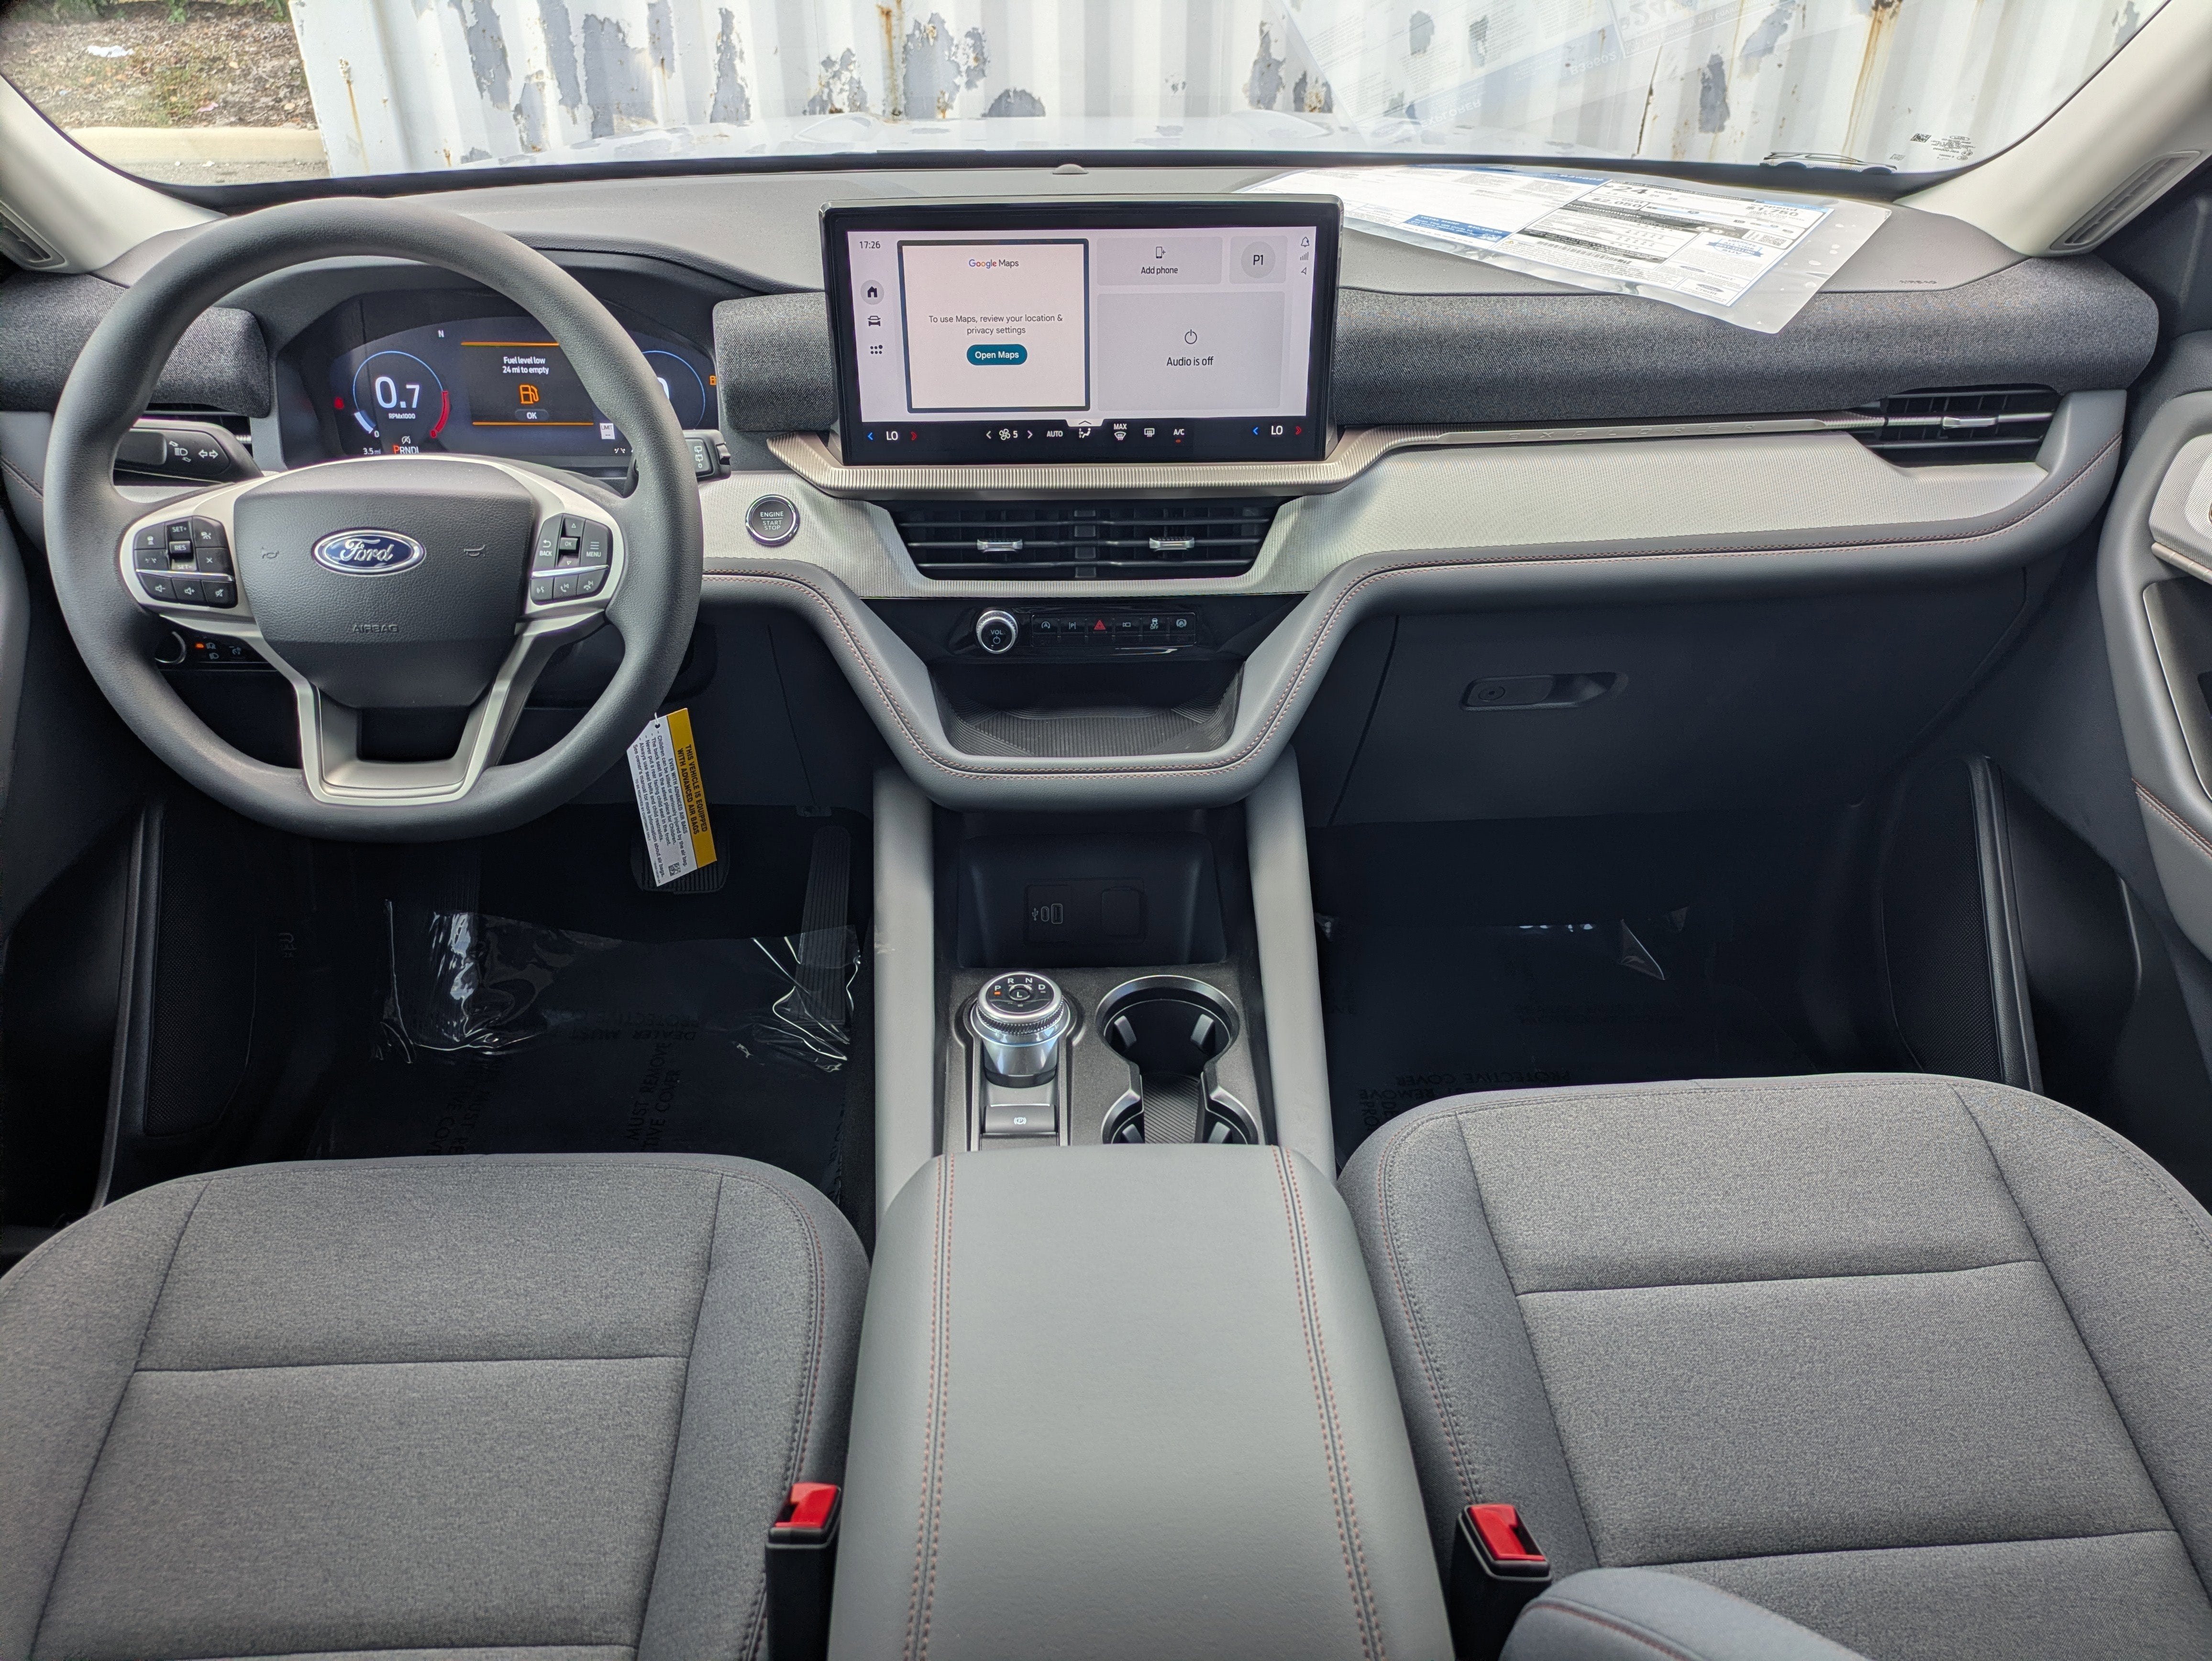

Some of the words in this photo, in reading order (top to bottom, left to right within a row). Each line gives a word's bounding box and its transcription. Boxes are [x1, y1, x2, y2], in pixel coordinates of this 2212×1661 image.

[859, 241, 881, 249] 17:26
[969, 259, 997, 269] Google
[999, 259, 1019, 268] Maps
[1252, 255, 1264, 266] P1
[1156, 266, 1178, 275] phone
[929, 315, 938, 323] To
[956, 315, 978, 324] Maps,
[980, 315, 1004, 323] review
[1006, 316, 1023, 324] your
[1025, 314, 1055, 323] location
[438, 330, 444, 338] N
[967, 327, 994, 336] privacy
[996, 326, 1026, 336] settings
[974, 351, 996, 361] Open
[998, 351, 1019, 361] Maps
[1166, 357, 1192, 366] Audio
[1193, 357, 1200, 366] is
[1201, 356, 1214, 366] off
[529, 366, 549, 375] empty
[375, 376, 420, 408] 0.7
[1013, 431, 1018, 439] 5
[1271, 426, 1283, 435] LO
[886, 432, 898, 441] LO
[340, 538, 395, 562] Ford
[352, 624, 399, 633] AIRBAG
[677, 747, 686, 767] WITH
[685, 743, 694, 761] THIS
[657, 735, 665, 757] Children
[668, 794, 677, 816] seriously
[688, 761, 699, 790] VEHICLE
[681, 766, 693, 803] ADVANCED
[638, 742, 646, 761] Always
[655, 817, 664, 842] restraints.
[694, 790, 701, 798] IS
[674, 785, 683, 811] ADVANCED
[696, 798, 708, 833] EQUIPPED
[647, 814, 657, 842] information
[690, 816, 699, 835] BAGS
[669, 822, 677, 845] Children.
